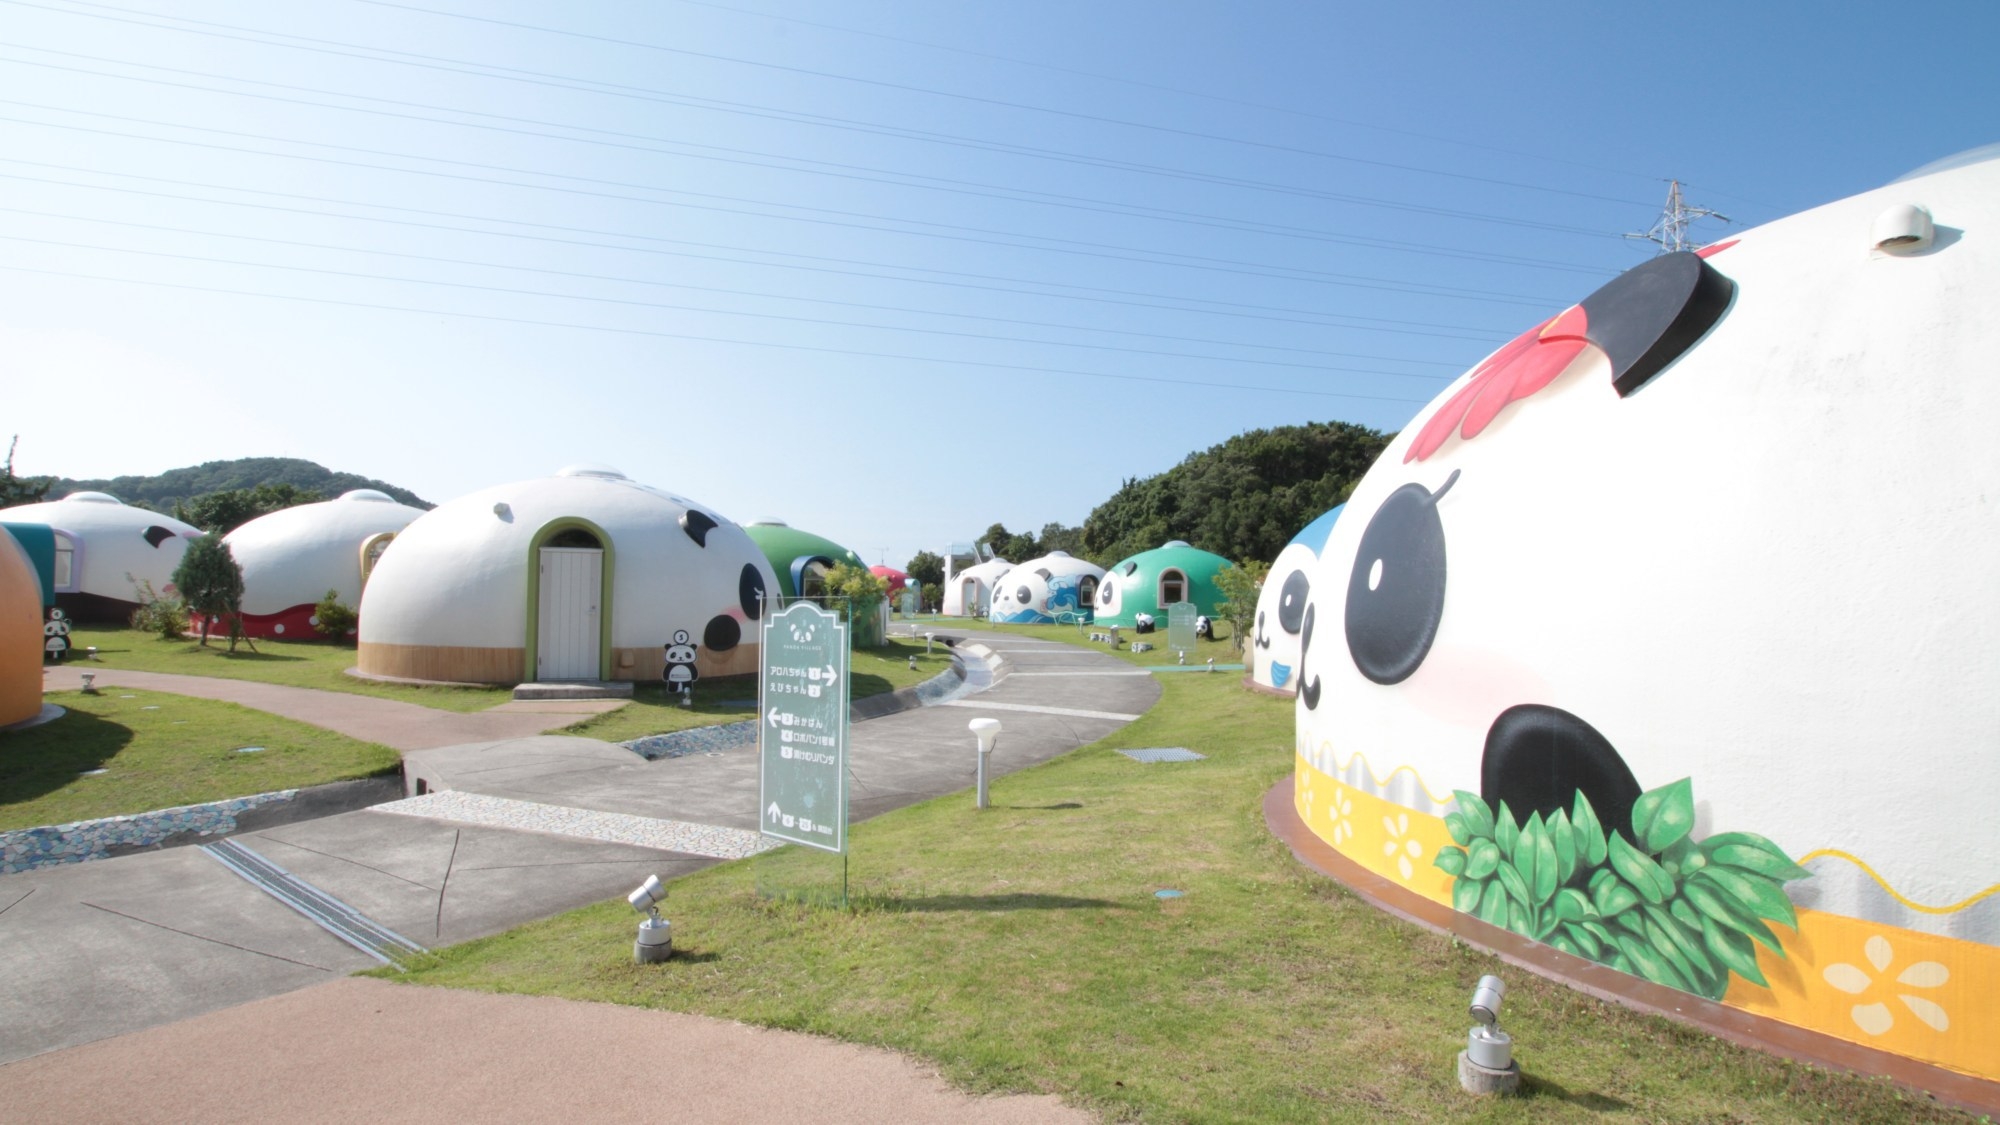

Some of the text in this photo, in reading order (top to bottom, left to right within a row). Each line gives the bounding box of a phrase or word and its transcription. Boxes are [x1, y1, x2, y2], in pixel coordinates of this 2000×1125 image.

[770, 666, 807, 678] アロハちゃん
[770, 682, 807, 695] えびちゃん
